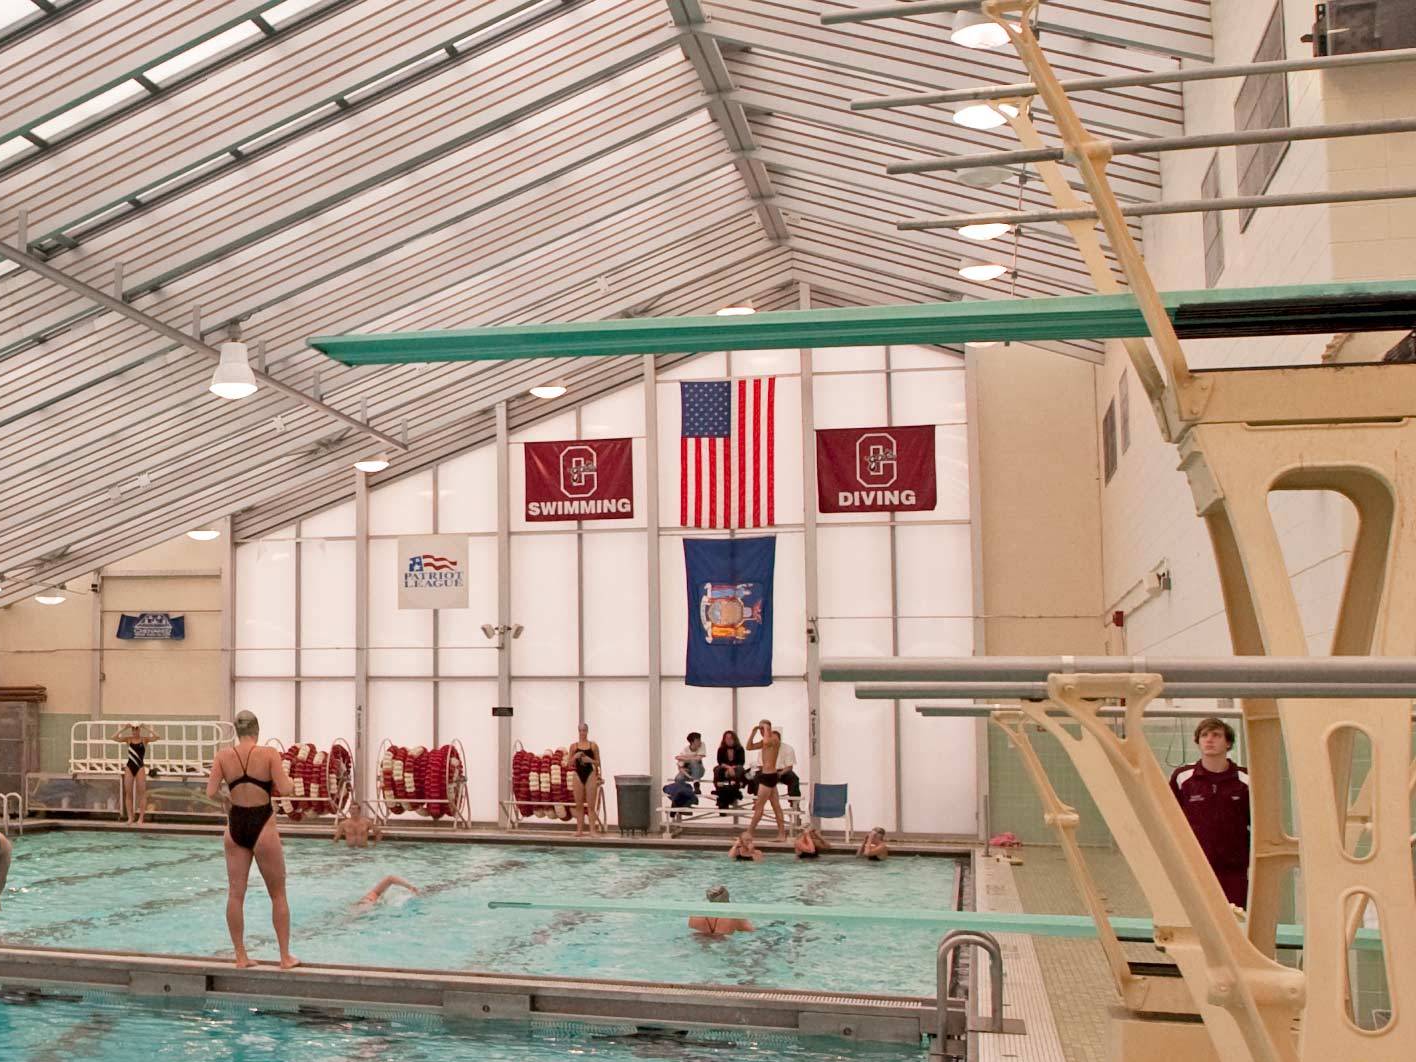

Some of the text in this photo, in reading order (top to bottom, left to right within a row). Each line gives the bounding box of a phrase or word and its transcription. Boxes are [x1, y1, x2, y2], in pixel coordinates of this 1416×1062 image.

[838, 490, 916, 507] DIVING
[527, 498, 632, 516] SWIMMING
[404, 572, 464, 580] PATRIOT
[404, 580, 464, 588] LEAGUE
